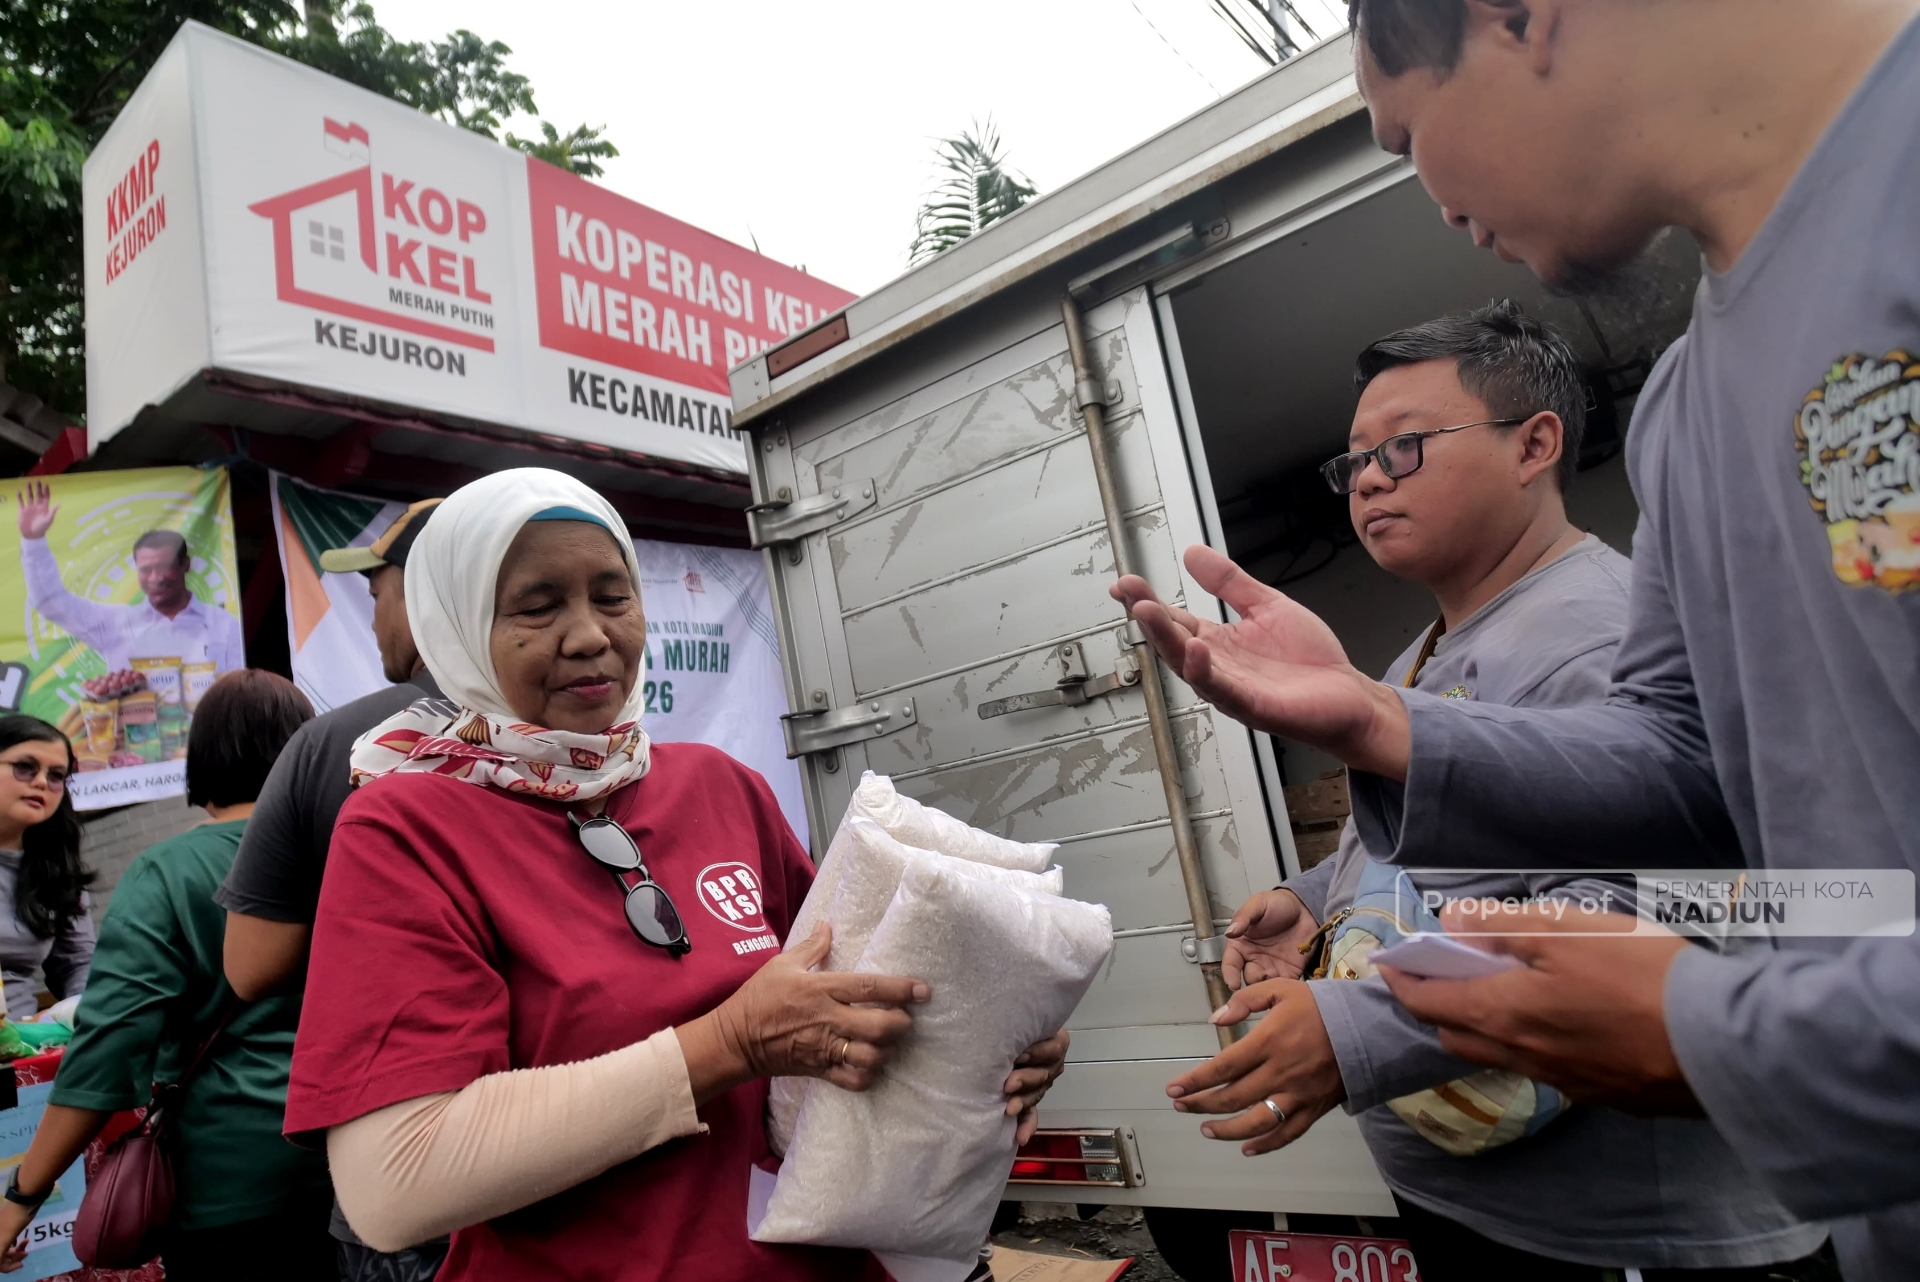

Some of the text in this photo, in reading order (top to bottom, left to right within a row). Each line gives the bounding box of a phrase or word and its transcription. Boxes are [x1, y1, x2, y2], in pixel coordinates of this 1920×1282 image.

[106, 138, 160, 243] KKMP
[381, 172, 486, 244] KOP
[106, 194, 166, 285] KEJURON
[385, 231, 492, 305] KEL
[554, 204, 754, 324] KOPERASI
[388, 287, 494, 329] MERAH PUTIH
[560, 272, 712, 367] MERAH
[314, 318, 466, 377] KEJURON
[661, 639, 730, 674] MURAH
[662, 621, 689, 634] KOTA
[691, 622, 723, 637] MADIUN
[702, 868, 757, 902] BPR
